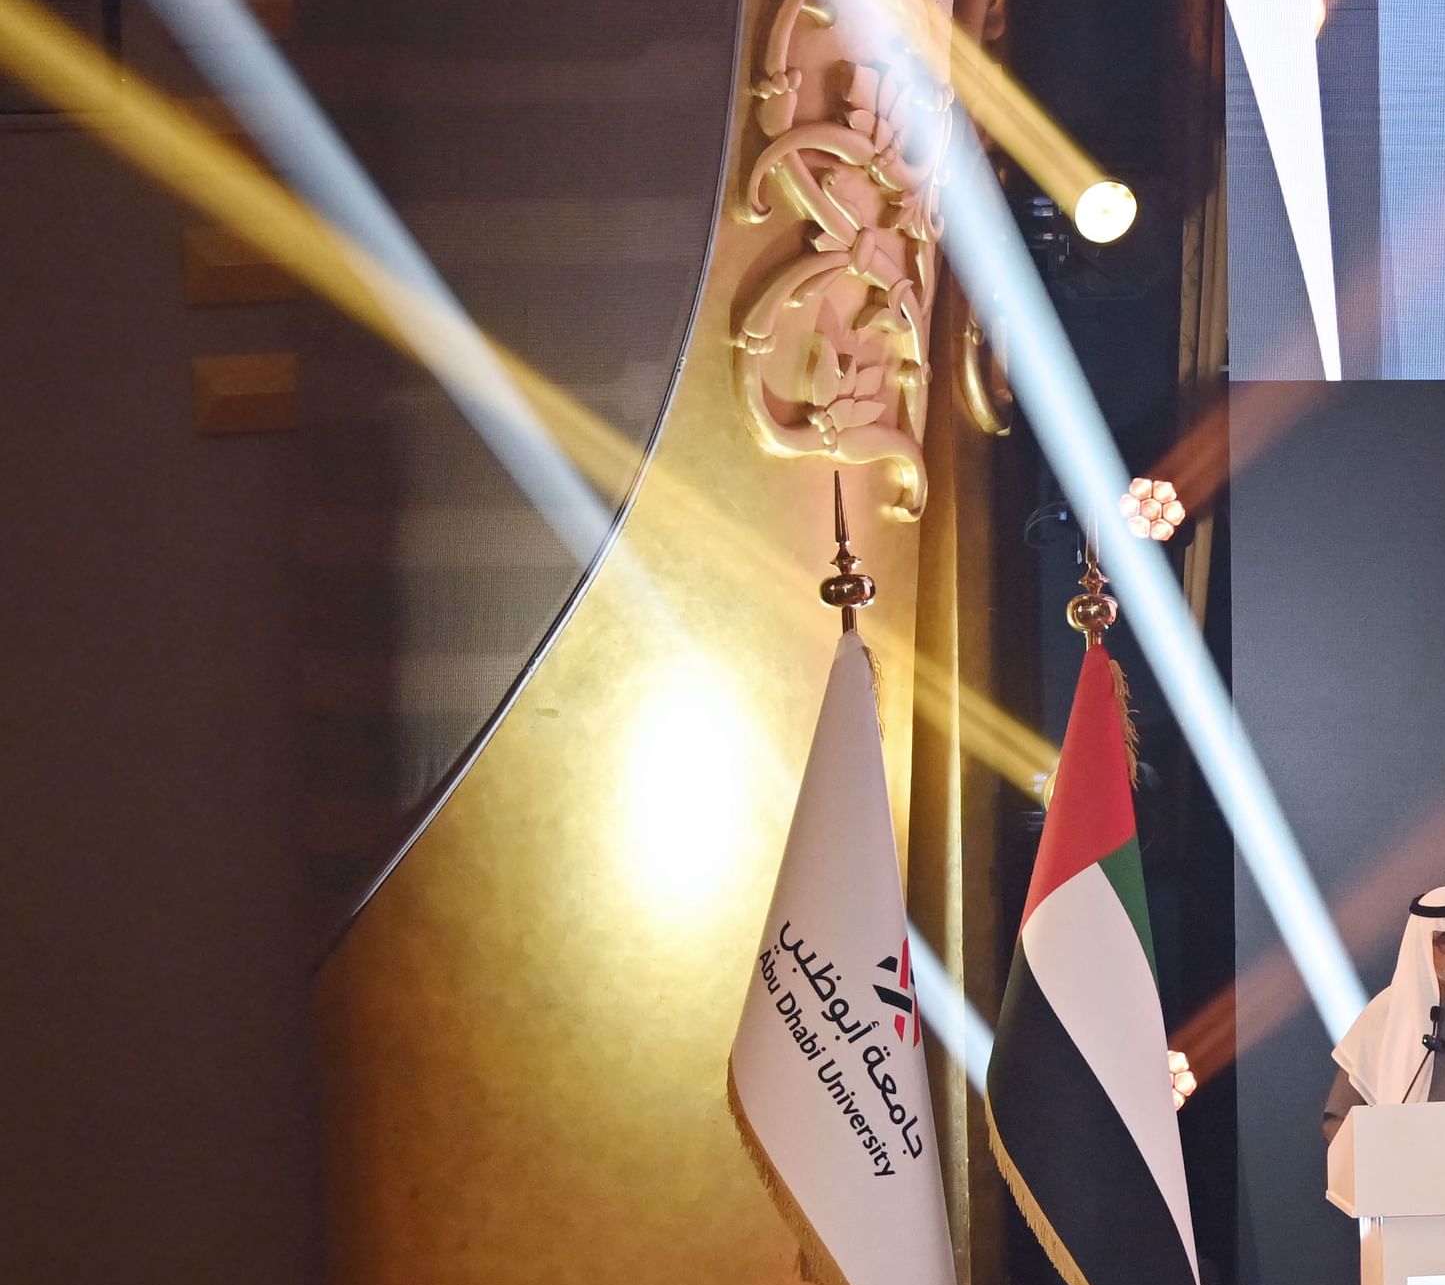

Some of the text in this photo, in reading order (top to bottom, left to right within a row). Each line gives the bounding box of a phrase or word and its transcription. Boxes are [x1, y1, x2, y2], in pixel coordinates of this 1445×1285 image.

[759, 950, 896, 1178] Abu Dhabi University
[774, 919, 923, 1160] جامعة أبوظبي
